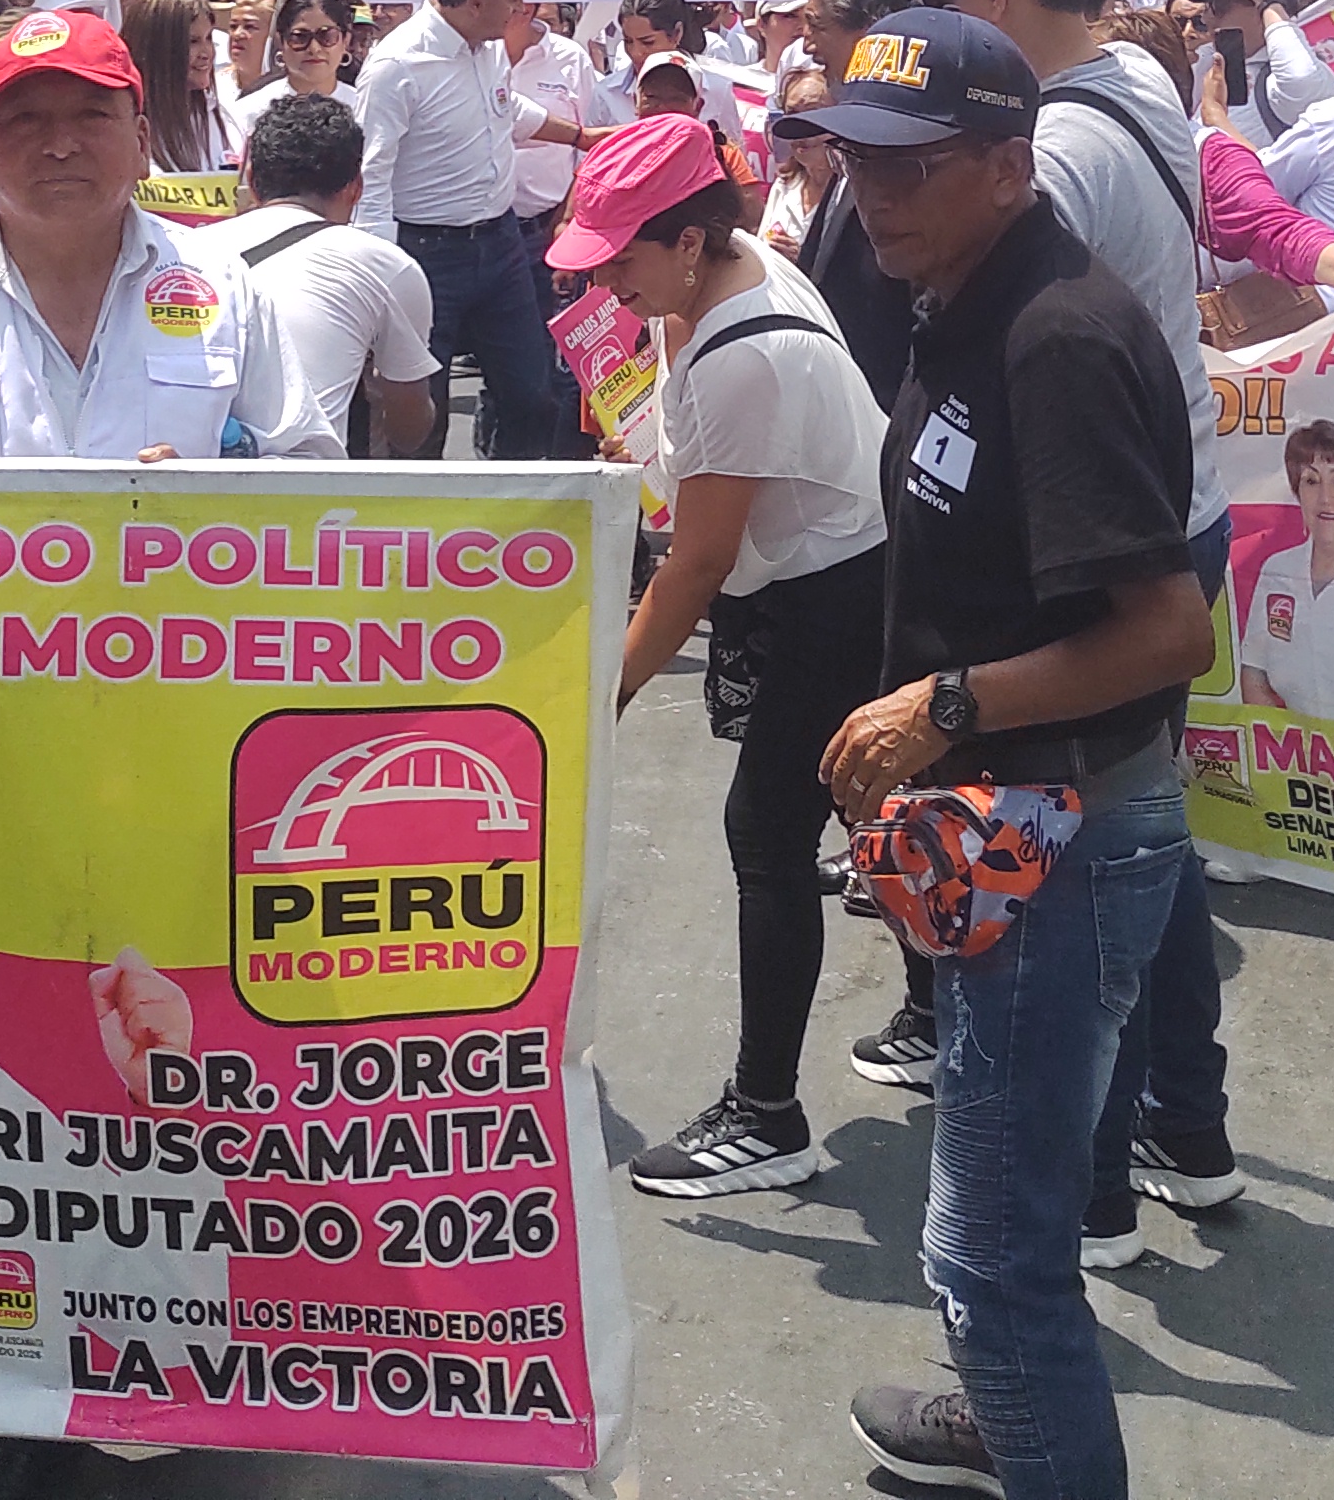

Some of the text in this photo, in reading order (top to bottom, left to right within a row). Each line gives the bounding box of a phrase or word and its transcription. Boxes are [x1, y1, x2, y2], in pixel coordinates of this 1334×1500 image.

[966, 87, 1007, 107] DEPORTIVO
[132, 181, 201, 206] RNIZAR
[201, 186, 230, 208] LA
[564, 293, 622, 351] CARLOS JAICO
[619, 379, 657, 420] CALENDAR
[939, 402, 970, 430] CALLAO
[935, 435, 950, 466] 1
[907, 476, 952, 515] VALDIVIA
[122, 510, 576, 589] POLÍTICO
[0, 614, 505, 684] MODERNO
[1286, 836, 1328, 860] LIMA
[250, 858, 526, 941] PERÚ
[247, 938, 528, 983] MODERNO
[148, 1031, 548, 1113] DR. JORGE
[64, 1105, 552, 1183] JUSCAMAITA
[377, 1189, 558, 1269] 2026
[61, 1289, 565, 1343] JUNTO CON LOS EMPRENDEDORES
[67, 1332, 576, 1425] LA VICTORIA
